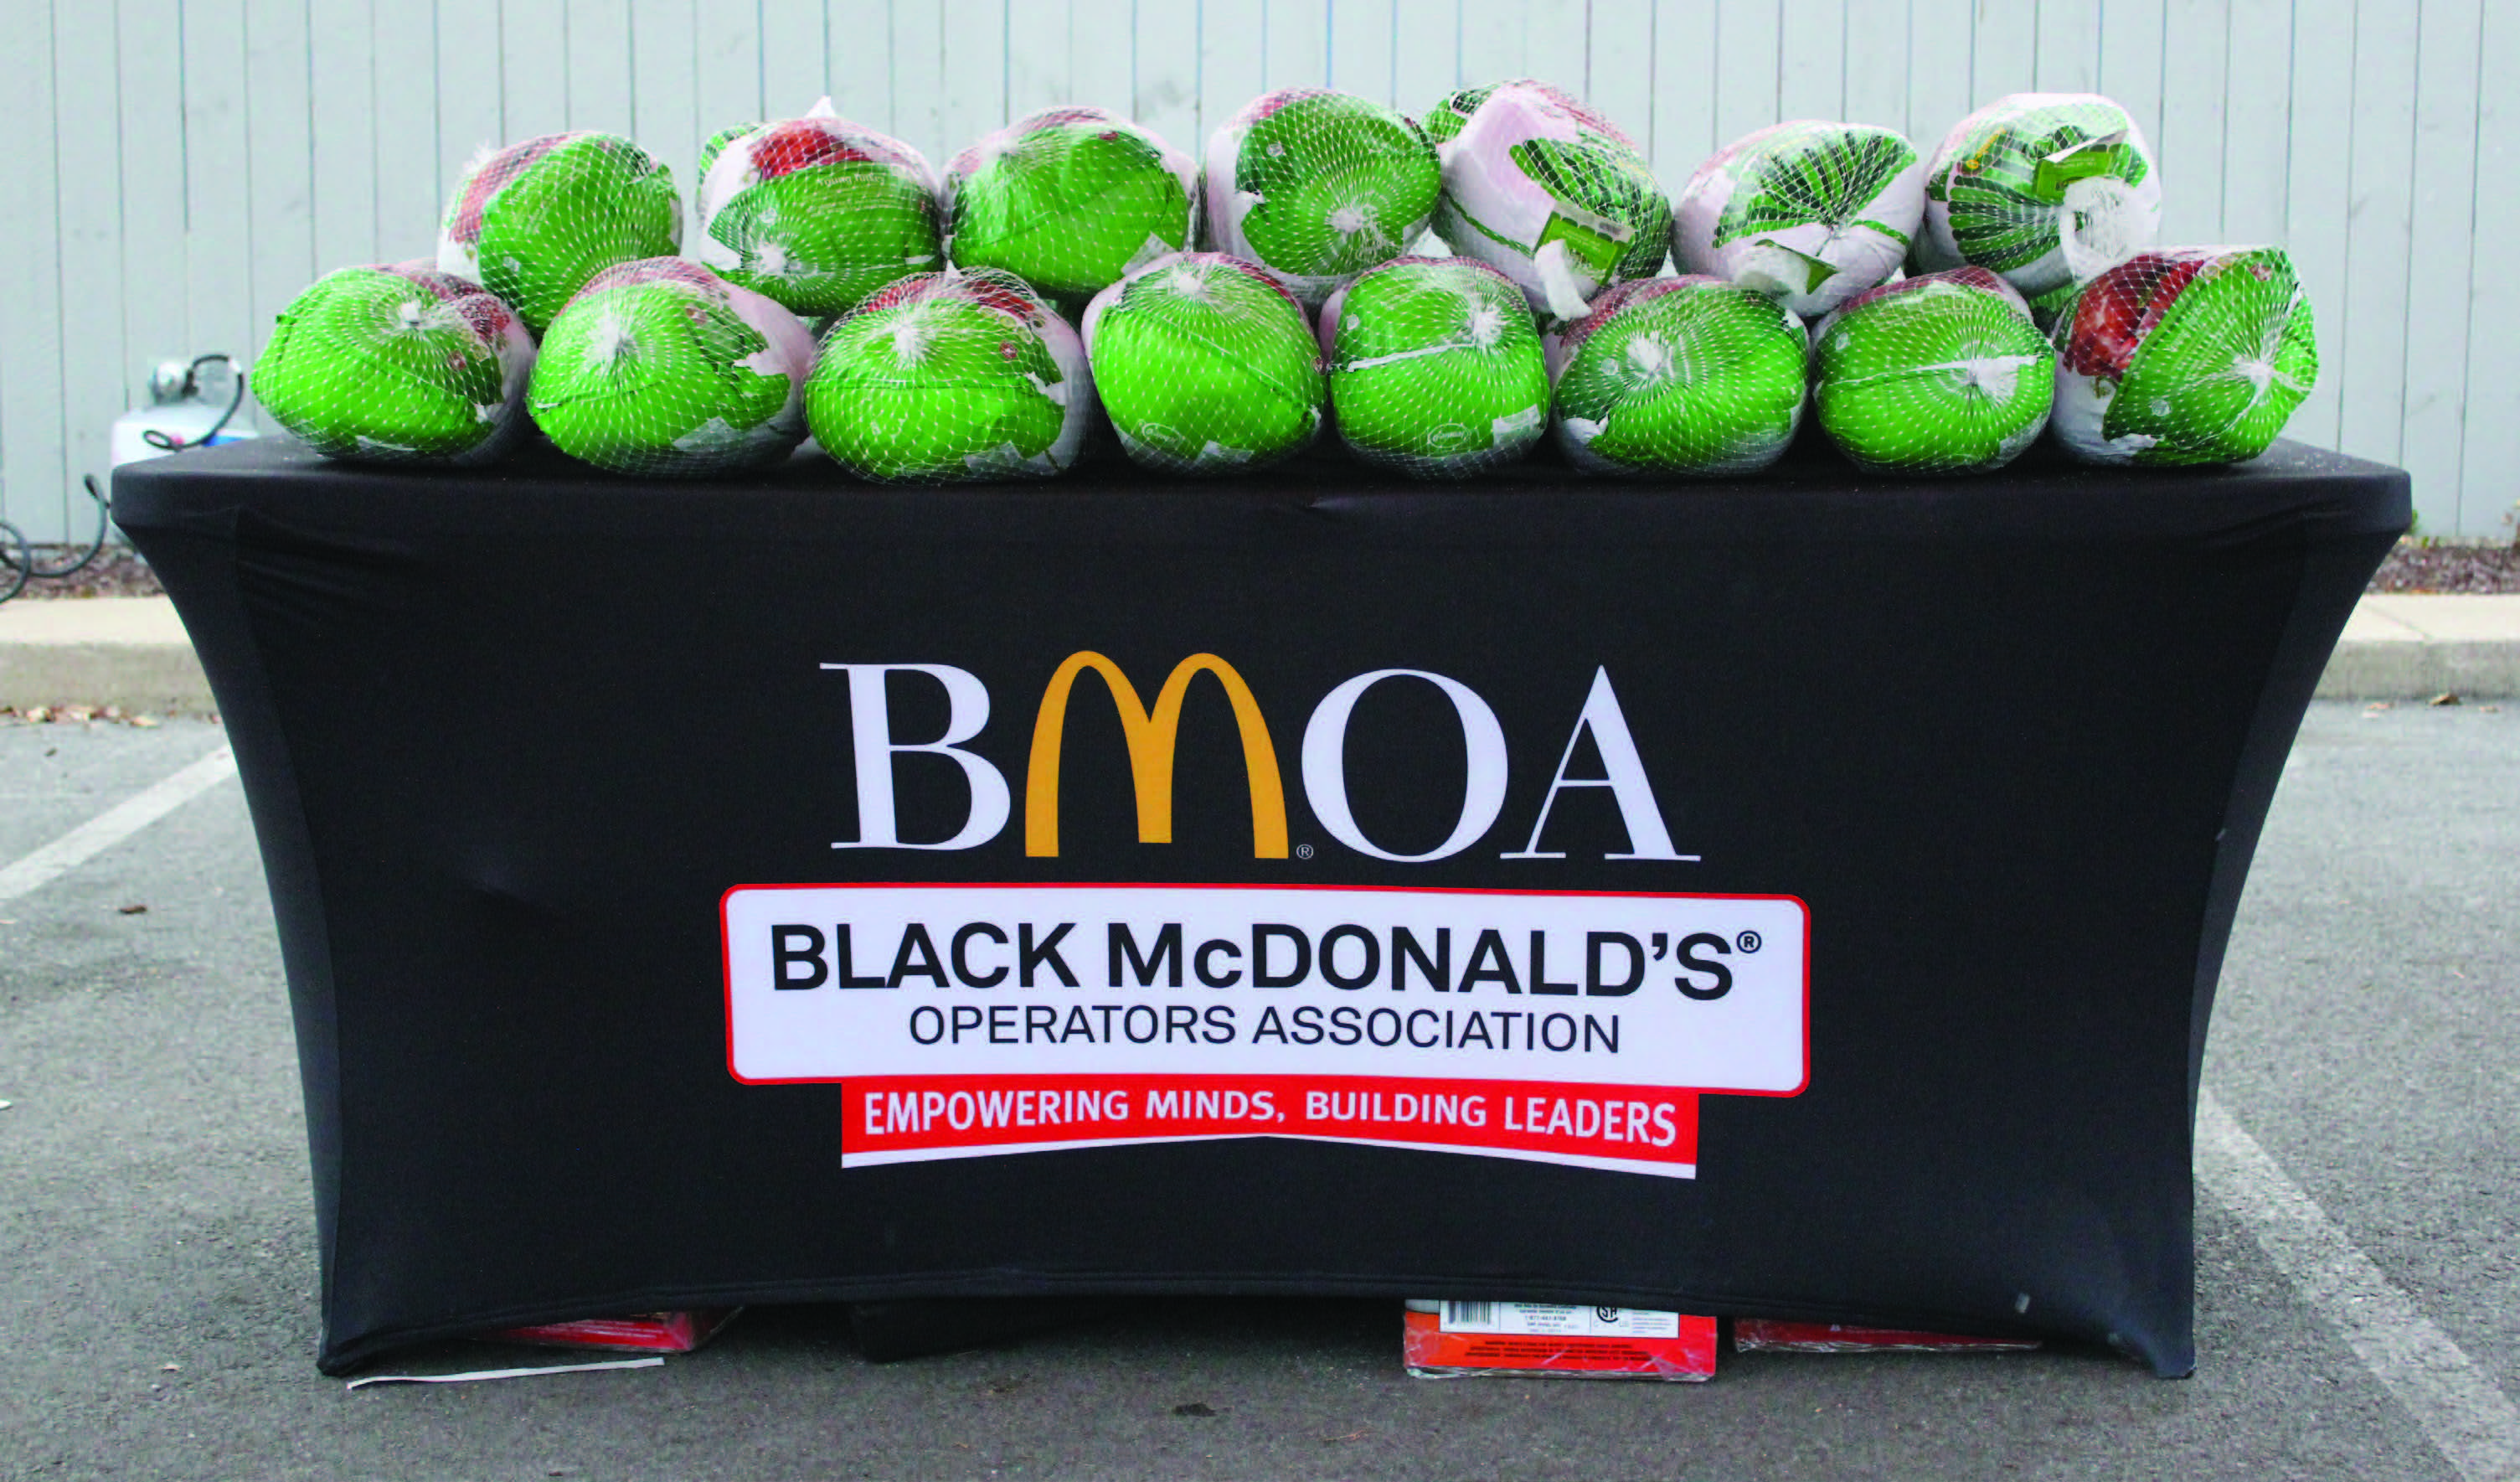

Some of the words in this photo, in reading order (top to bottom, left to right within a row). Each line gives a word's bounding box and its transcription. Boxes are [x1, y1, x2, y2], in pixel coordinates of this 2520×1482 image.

[771, 922, 1080, 991] BLACK
[910, 1005, 1236, 1046] OPERATORS
[1252, 1006, 1620, 1054] ASSOCIATION
[863, 1090, 1129, 1136] EMPOWERING
[1145, 1090, 1286, 1124] MINDS,
[1306, 1091, 1487, 1128] BUILDING
[1504, 1094, 1677, 1148] LEADERS
